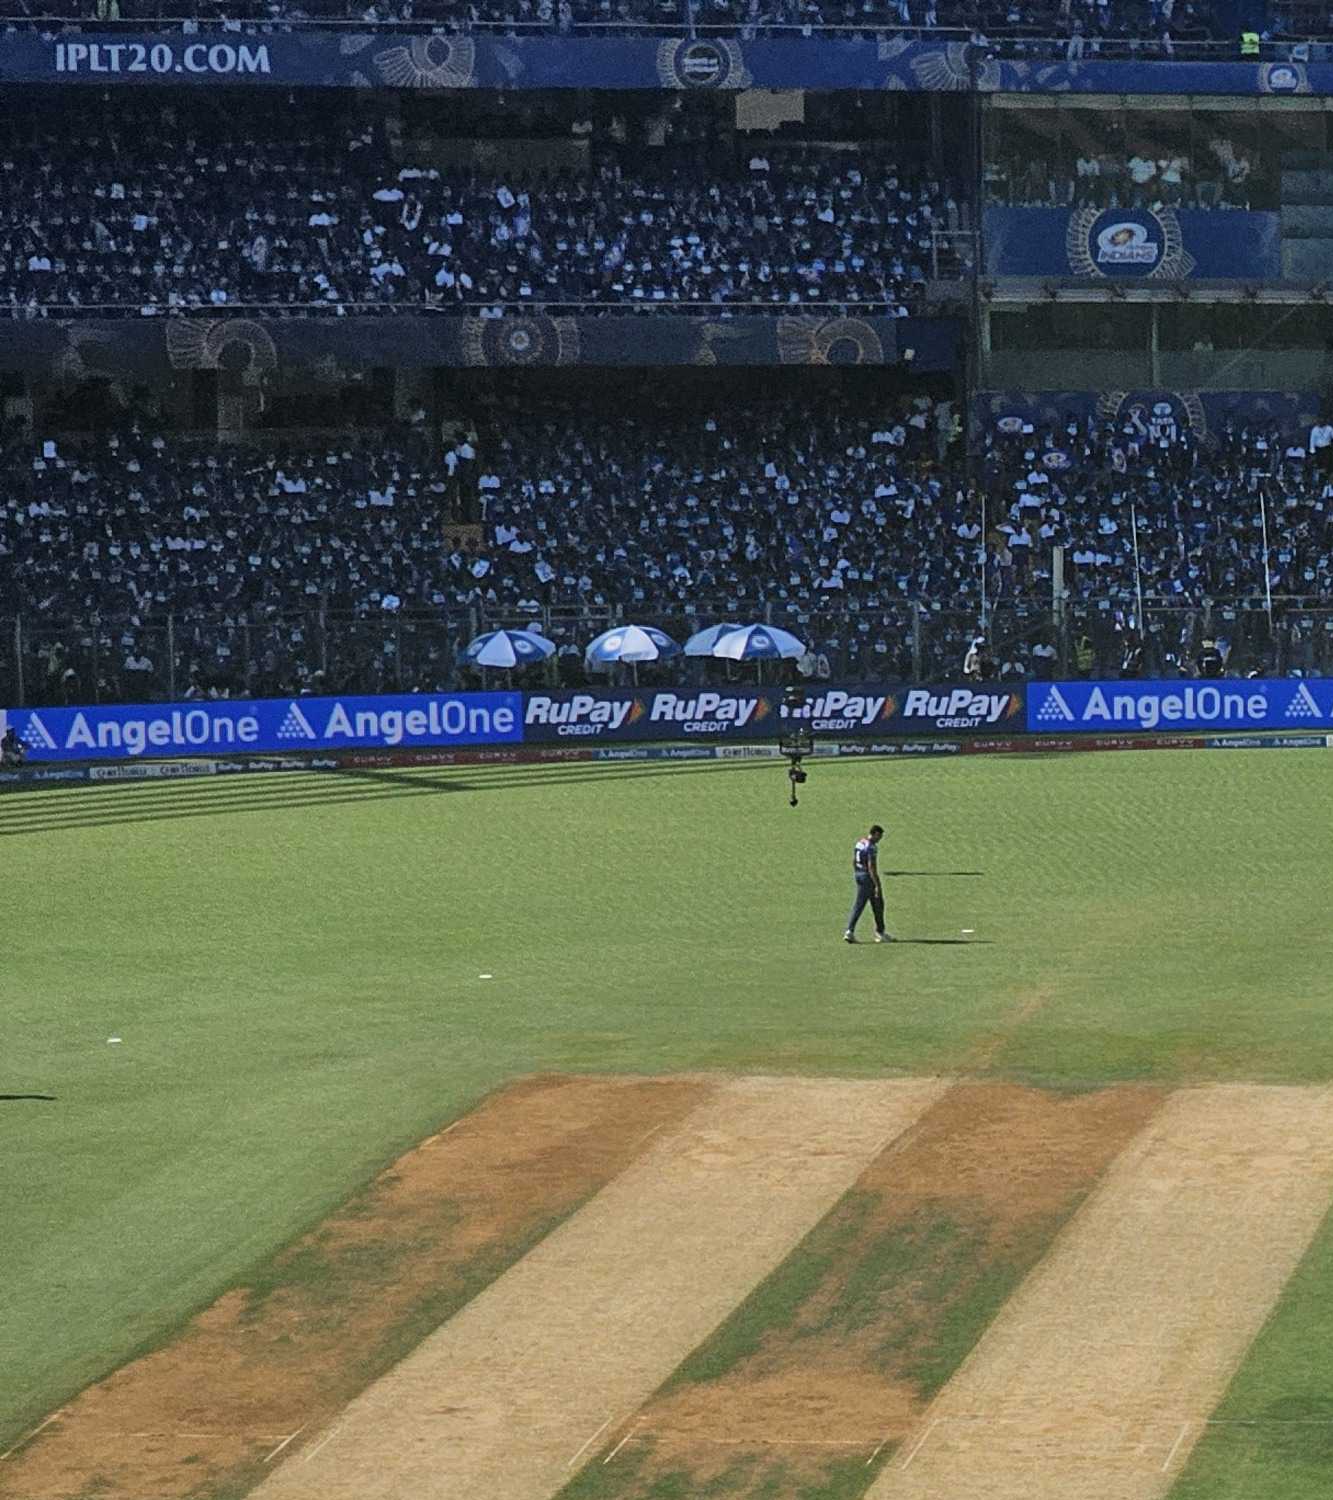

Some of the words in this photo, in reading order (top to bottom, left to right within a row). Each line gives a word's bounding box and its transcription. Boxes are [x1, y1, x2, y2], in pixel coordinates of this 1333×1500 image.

[56, 43, 271, 74] IPLT20.COM
[324, 700, 514, 746] AngelOne
[525, 694, 632, 729] RuPay
[649, 692, 758, 727] RuPay
[903, 688, 1011, 725] RuPay
[936, 716, 981, 728] CREDIT
[1083, 685, 1267, 729] AngelOne
[66, 709, 259, 754] AngelOne
[557, 723, 603, 735] CREDIT
[683, 719, 729, 732] CREDIT
